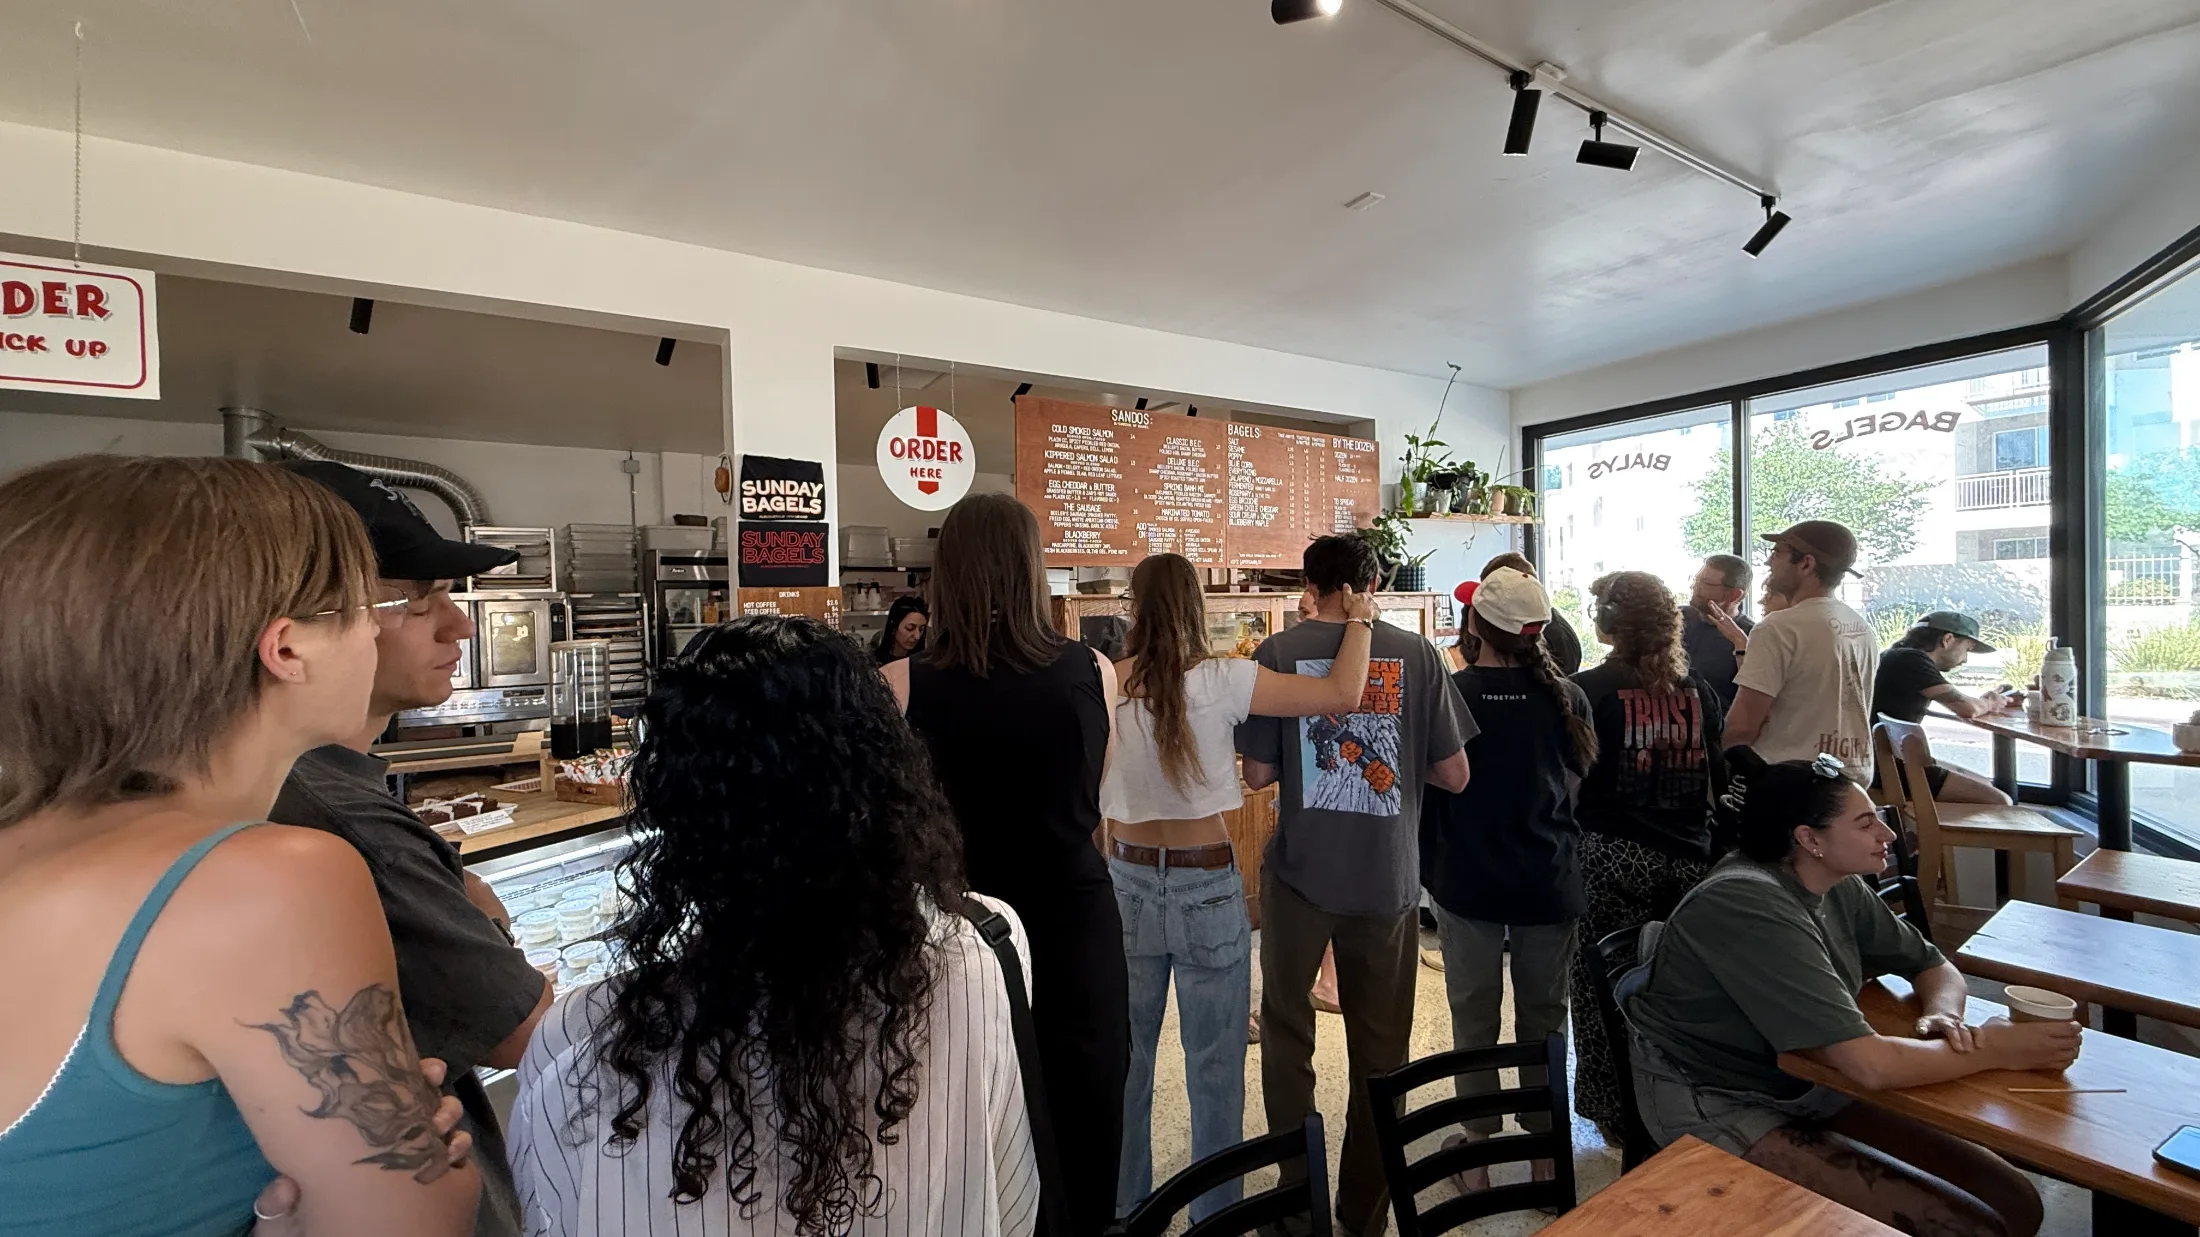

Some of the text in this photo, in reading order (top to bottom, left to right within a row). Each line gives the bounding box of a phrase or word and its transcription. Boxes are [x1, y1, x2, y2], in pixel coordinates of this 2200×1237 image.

[65, 338, 108, 357] UP
[1052, 424, 1067, 433] COLD
[1069, 426, 1091, 435] SMOKED
[1092, 429, 1113, 438] SALMON
[1166, 437, 1188, 446] CLASSIC
[1228, 437, 1239, 445] SALT
[1333, 437, 1341, 448] BY
[1342, 439, 1354, 450] THE
[889, 437, 963, 463] ORDER
[1228, 445, 1245, 454] SESAME
[1045, 450, 1074, 460] KIPPERED
[1076, 453, 1098, 462] SALMON
[1099, 454, 1118, 464] SALAD
[1334, 451, 1347, 459] DOZEN
[1167, 457, 1186, 466] DELUXE
[910, 467, 943, 479] HERE
[1229, 467, 1256, 476] EVERYTHING
[1255, 476, 1282, 485] MOZZARELLA
[741, 479, 824, 498] SUNDAY
[1062, 481, 1087, 490] CHEDDAR
[1093, 483, 1115, 491] BUTTER
[1163, 483, 1204, 493] SPRING BANH MI
[1229, 482, 1254, 490] FERMENTED
[1229, 489, 1251, 497] ROSEMARY
[742, 496, 822, 514] BAGELS
[1239, 497, 1258, 505] BRIOCHE
[1077, 504, 1101, 512] SAUSAGE
[1259, 505, 1279, 513] CHEDDAR
[1162, 508, 1190, 517] MARINATED
[1191, 510, 1210, 518] TOMATO
[1229, 518, 1254, 526] BLUEBERRY
[741, 530, 825, 548] SUNDAY
[1065, 530, 1101, 539] BLACKBERRY
[743, 547, 825, 564] BAGELS
[1617, 687, 1702, 749] TRUST
